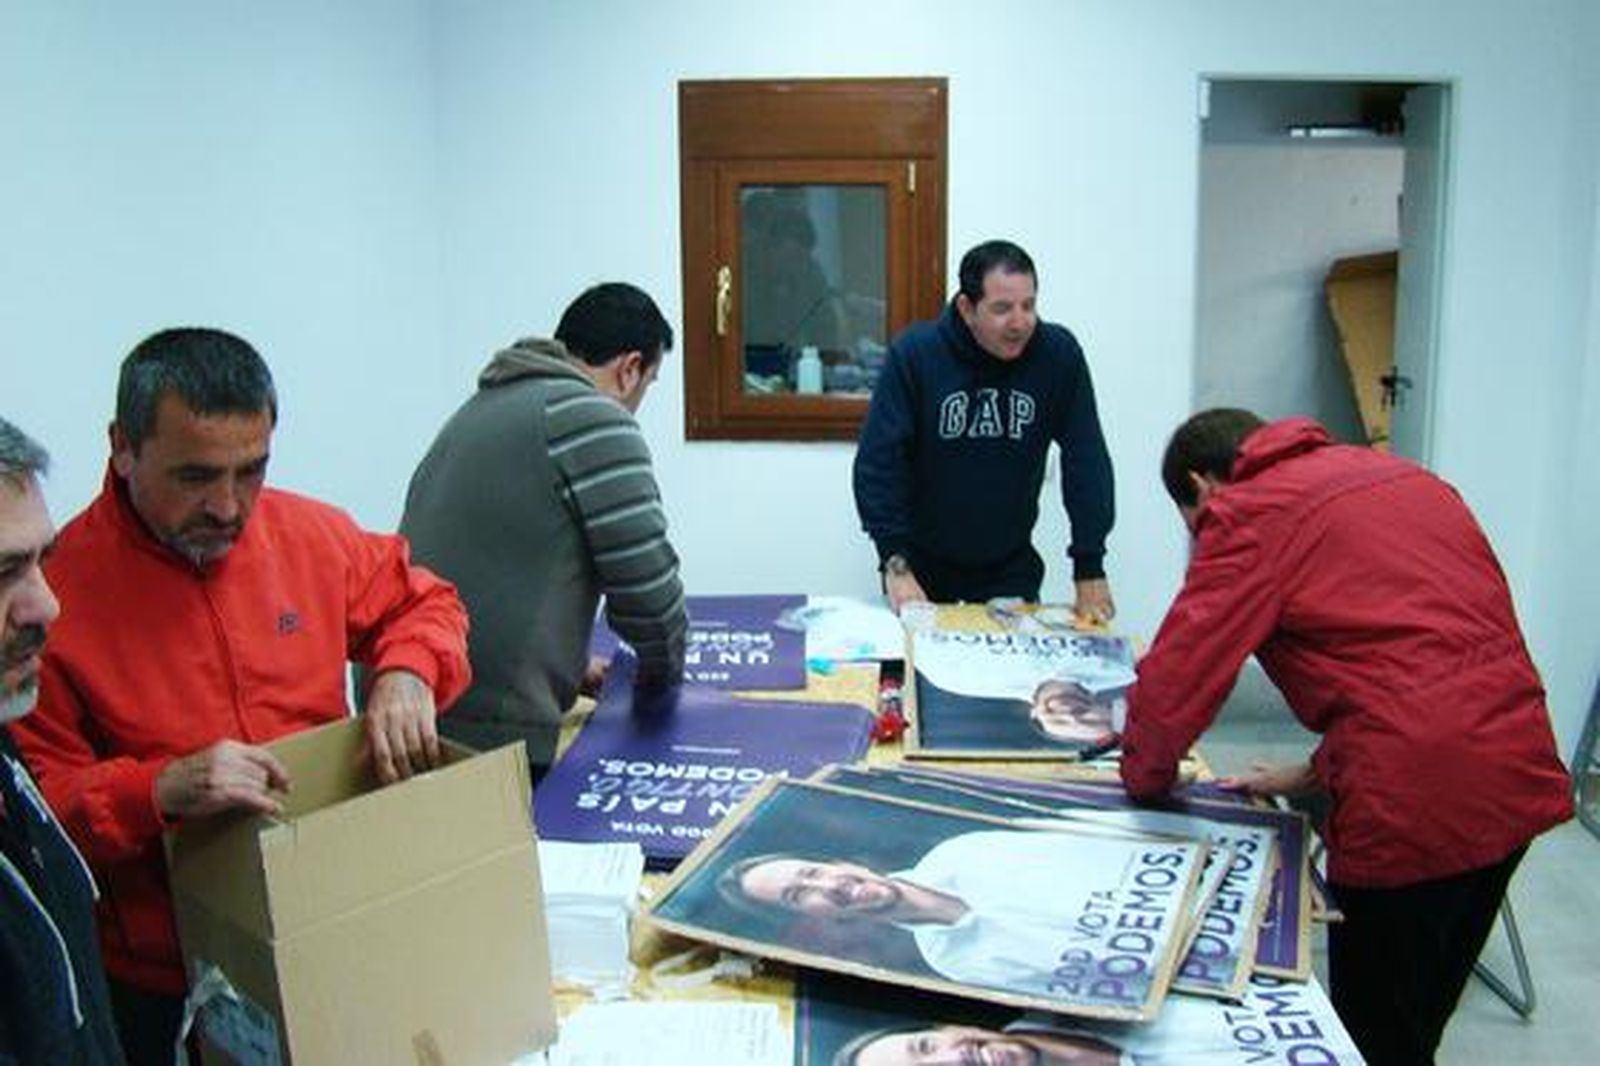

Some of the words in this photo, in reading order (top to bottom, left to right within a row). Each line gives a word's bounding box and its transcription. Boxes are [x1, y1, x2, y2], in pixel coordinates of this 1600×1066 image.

[939, 388, 1036, 440] GAP
[718, 650, 771, 664] UN
[1069, 890, 1116, 943] VOTA
[1088, 848, 1188, 1003] PODEMOS.
[1047, 948, 1093, 995] 20D
